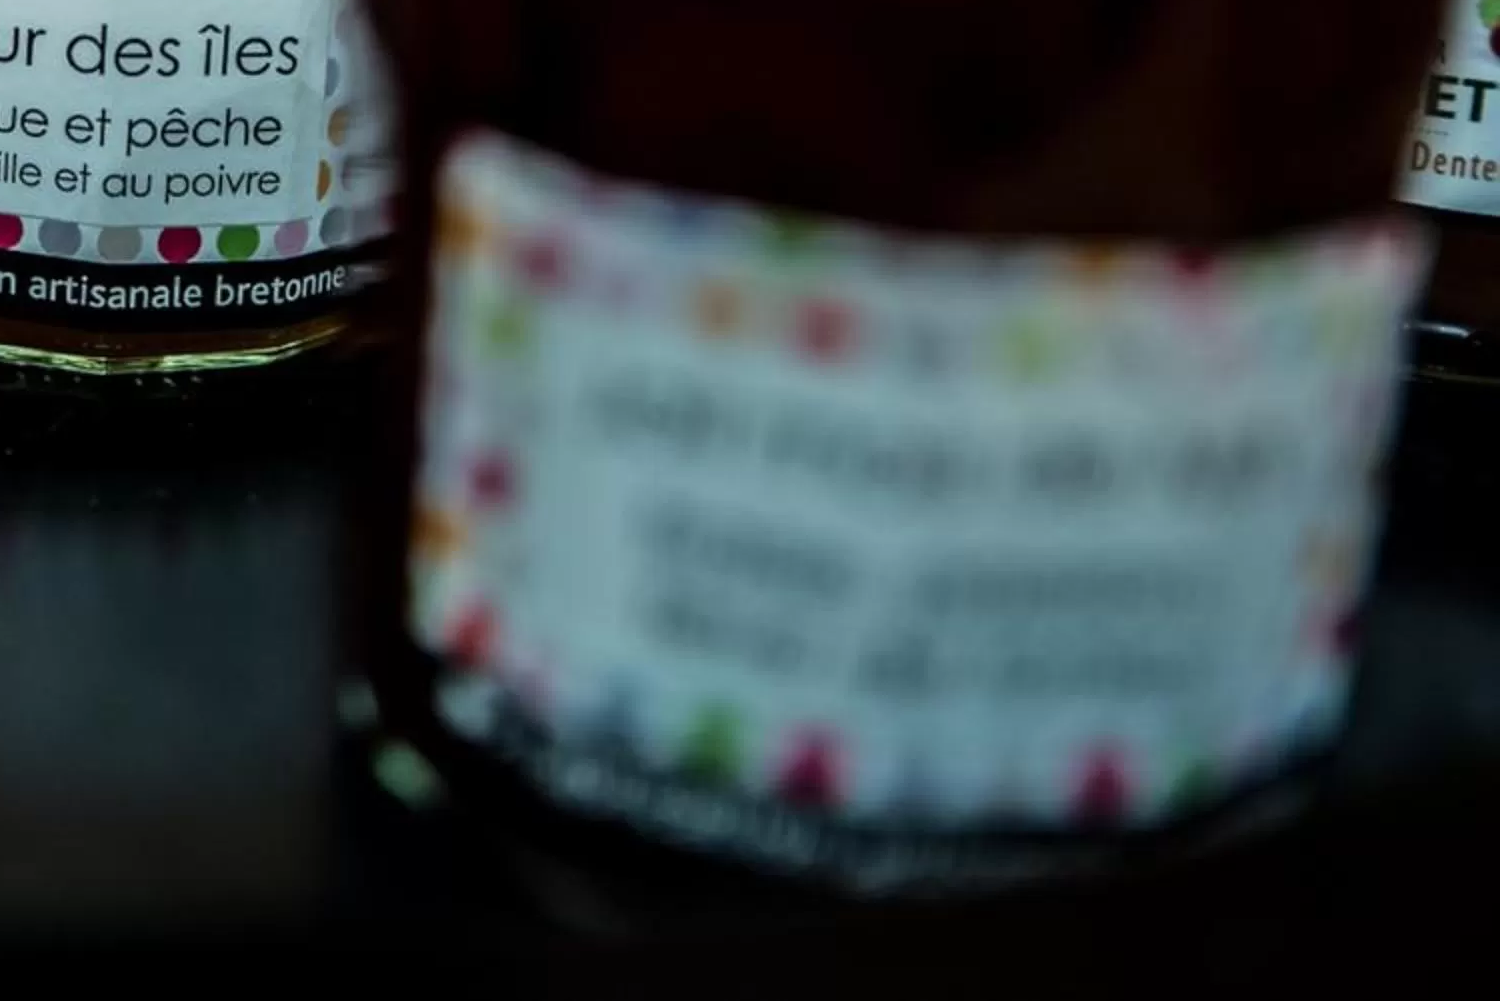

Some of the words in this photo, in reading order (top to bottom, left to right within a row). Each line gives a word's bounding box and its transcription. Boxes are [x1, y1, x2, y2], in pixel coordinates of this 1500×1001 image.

[66, 24, 181, 77] des
[198, 23, 300, 77] îles
[1425, 74, 1497, 123] ET
[65, 111, 111, 146] et
[127, 108, 282, 156] pêche
[54, 167, 91, 195] et
[102, 171, 152, 198] au
[165, 165, 281, 205] poivre
[29, 277, 202, 309] artisanale
[215, 265, 345, 308] bretonne
